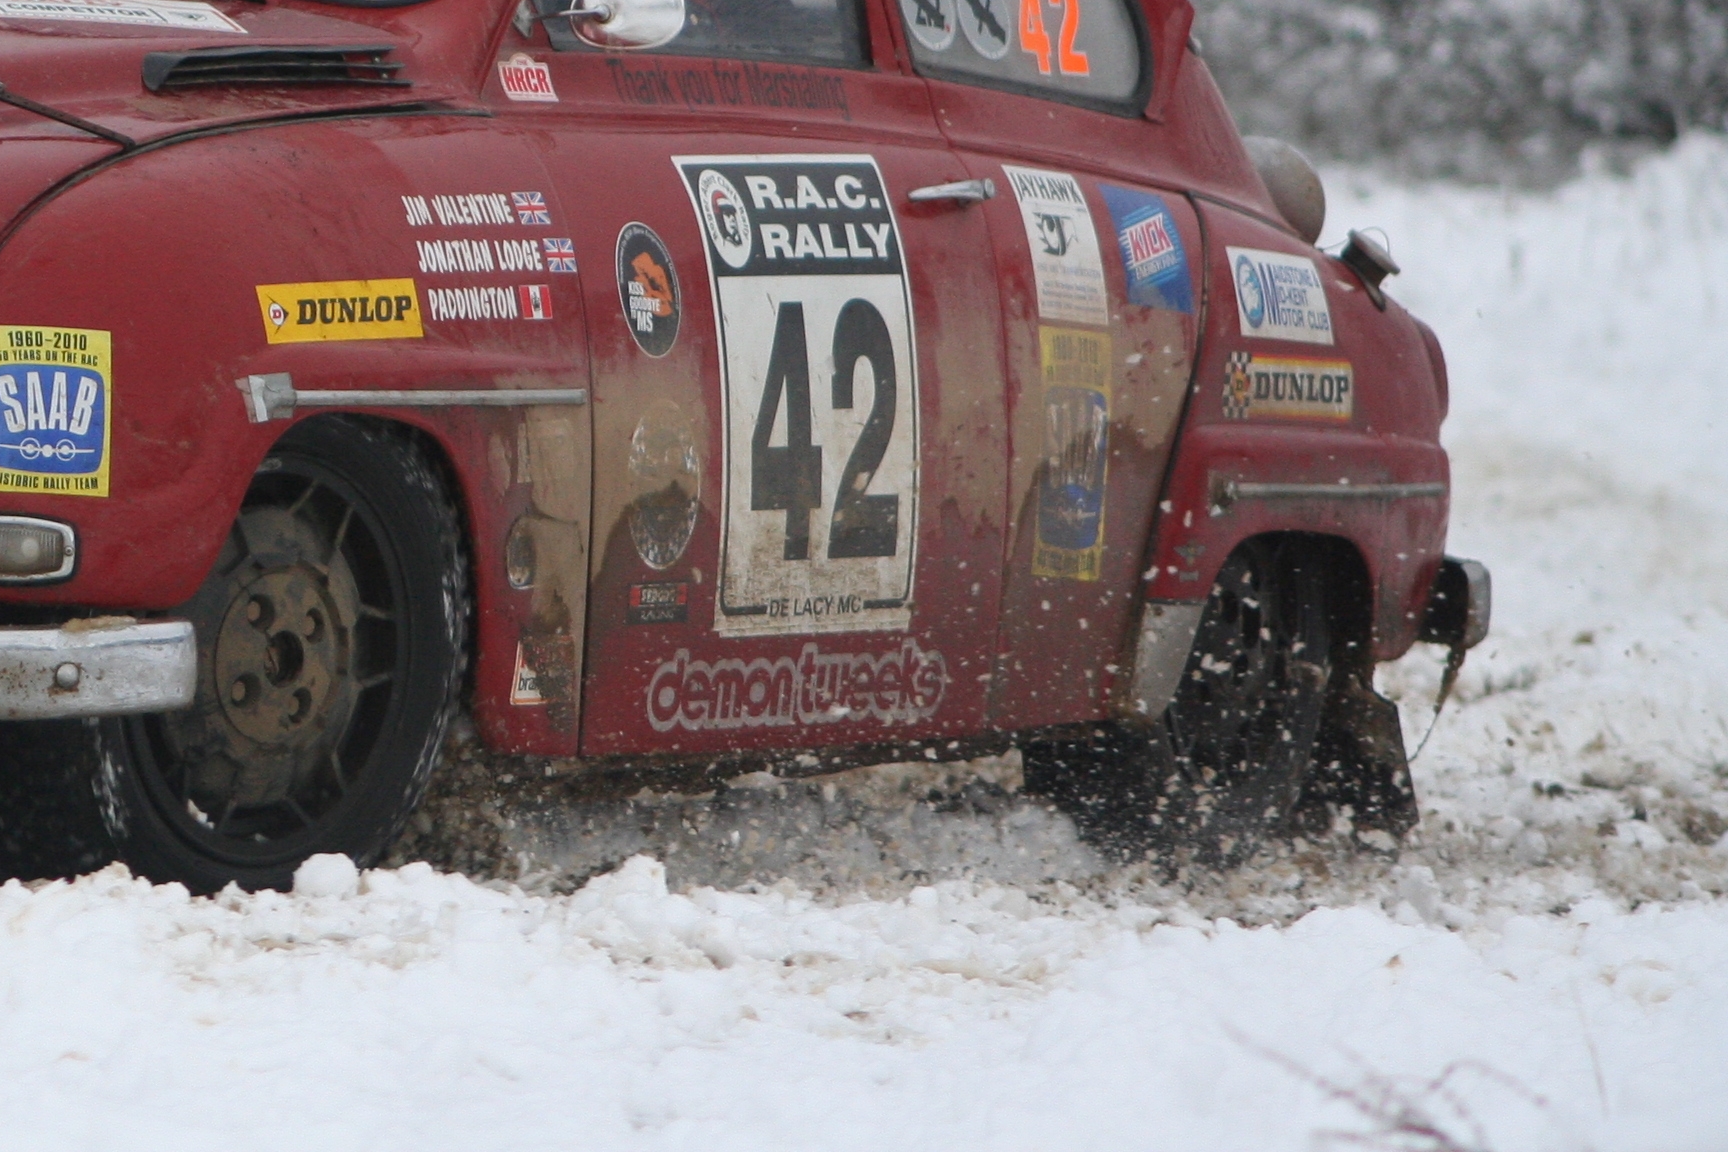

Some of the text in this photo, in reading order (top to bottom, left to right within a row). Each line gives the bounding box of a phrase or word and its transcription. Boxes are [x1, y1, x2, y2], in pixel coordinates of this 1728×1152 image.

[6, 2, 150, 18] COMPETITOR
[502, 67, 551, 94] HRCR
[605, 58, 677, 104] Thank
[674, 70, 715, 112] you
[712, 61, 742, 105] for
[744, 175, 880, 210] R.A.C.
[1010, 171, 1083, 205] JAYHAWK
[401, 193, 514, 226] JIM VALENTINE
[759, 223, 889, 259] RALLY
[1128, 215, 1173, 264] KICK
[416, 239, 543, 273] JONATHAN LODGE
[628, 280, 644, 296] KISS
[297, 295, 412, 325] DUNLOP
[428, 286, 518, 321] PADDINGTON
[629, 295, 660, 312] GOODBYE
[636, 311, 653, 332] MS
[1307, 310, 1330, 330] CLUB
[7, 331, 87, 351] 1960-2010
[12, 350, 41, 362] YEARS
[46, 350, 58, 362] ON
[62, 351, 77, 364] THE
[81, 354, 99, 367] RAC
[1254, 371, 1349, 403] DUNLOP
[751, 298, 899, 560] 42
[43, 476, 71, 490] RALLY
[75, 476, 99, 490] TEAM
[769, 594, 862, 617] DE LACY MC
